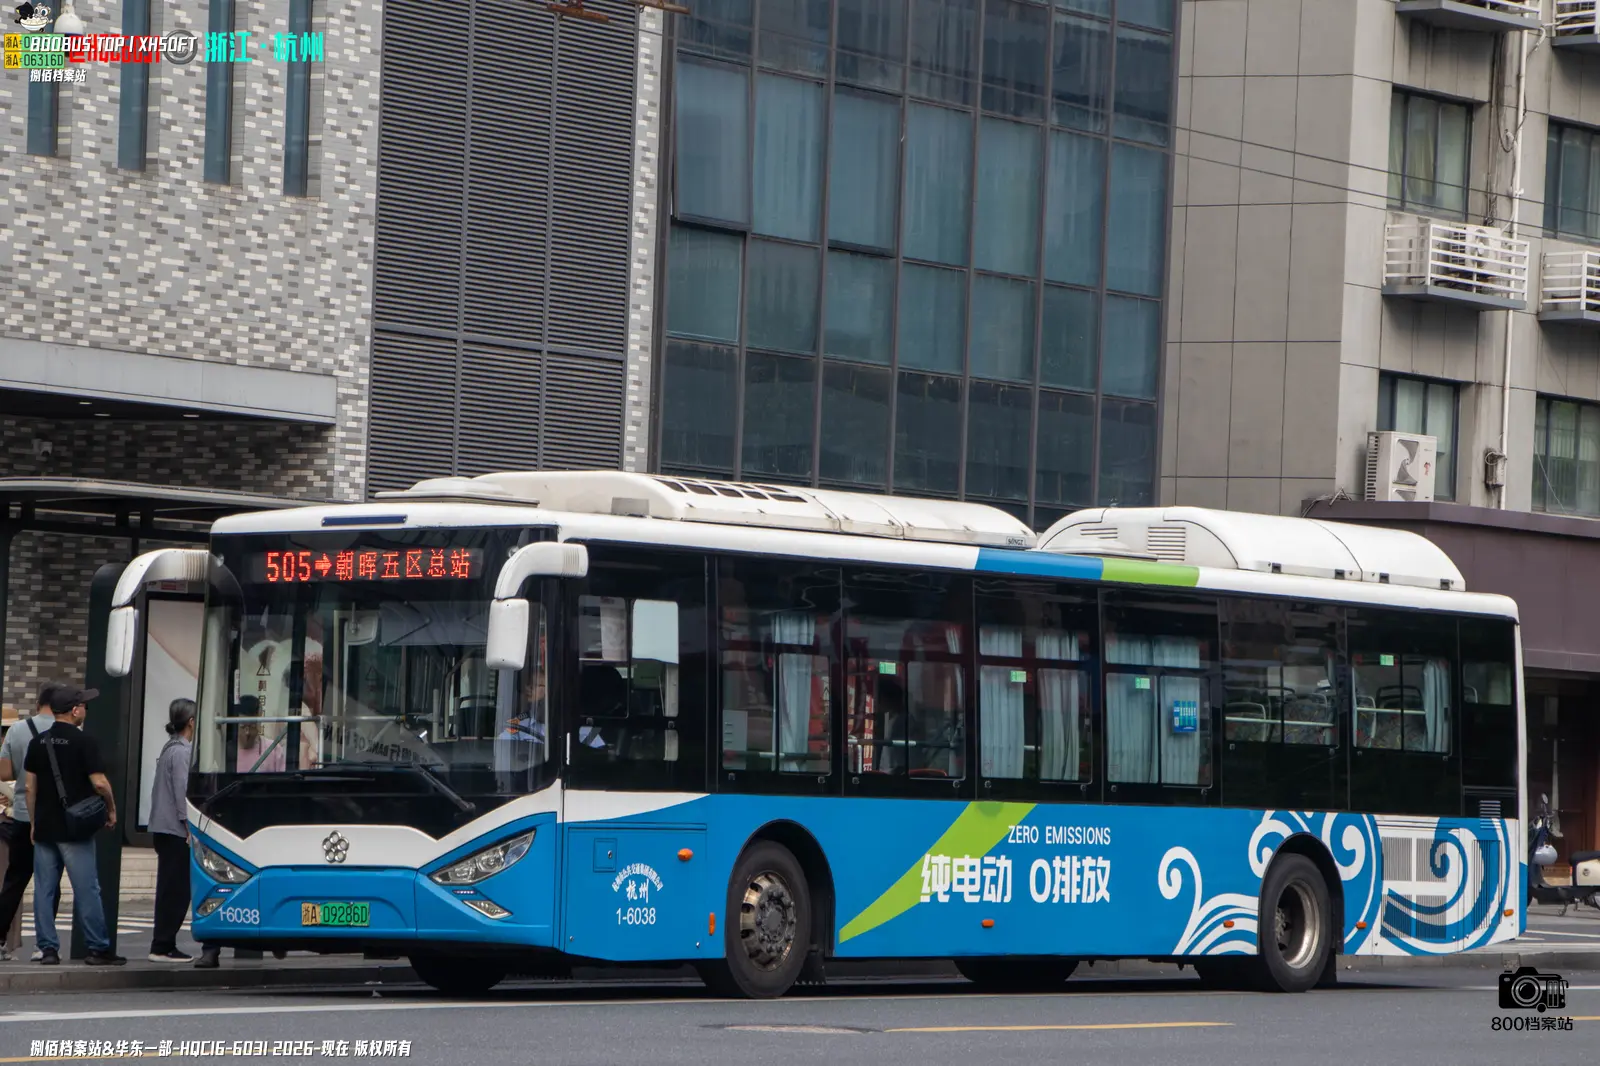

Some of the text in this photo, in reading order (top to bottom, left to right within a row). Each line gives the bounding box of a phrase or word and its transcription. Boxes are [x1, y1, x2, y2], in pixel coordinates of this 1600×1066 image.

[266, 549, 471, 582] 505 朝晖五区总站
[1007, 825, 1111, 846] ZERO EMISSIONS
[920, 854, 1013, 903] 纯电动
[625, 878, 650, 904] 杭州
[218, 906, 260, 925] 1-6038
[616, 906, 656, 925] 1-6038
